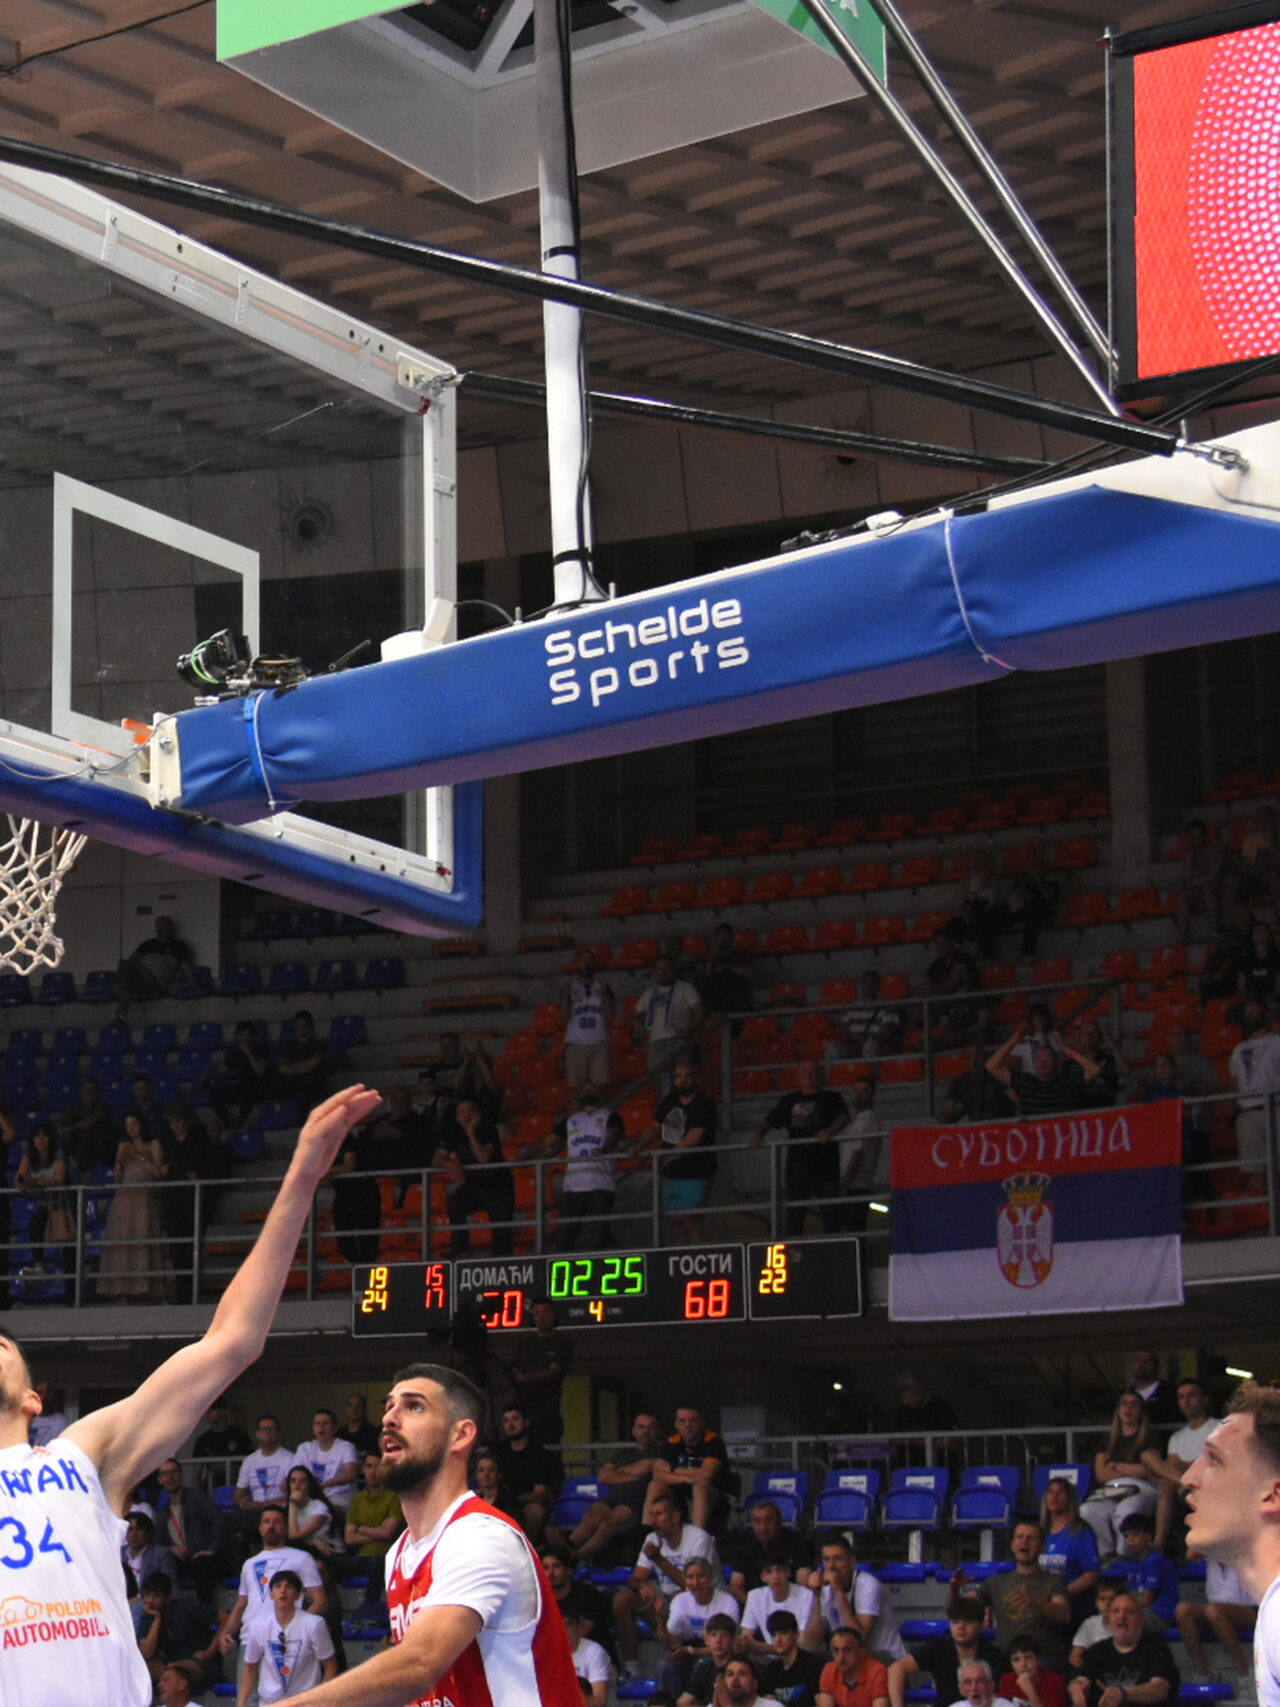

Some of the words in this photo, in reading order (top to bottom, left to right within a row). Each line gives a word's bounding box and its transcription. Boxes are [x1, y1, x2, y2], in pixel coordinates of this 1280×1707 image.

[544, 598, 742, 668] Schelde
[549, 637, 750, 708] Sports
[931, 1115, 1132, 1168] СУБОТИЦА
[668, 1253, 733, 1277] ГОСТИ
[766, 1243, 786, 1269] 16
[368, 1265, 389, 1290] 19
[425, 1264, 444, 1287] 15
[459, 1264, 534, 1291] ДОМАЋИ
[758, 1268, 787, 1294] 22
[361, 1289, 388, 1313] 24
[425, 1287, 446, 1309] 17
[588, 1300, 604, 1322] 4
[684, 1278, 730, 1319] 68
